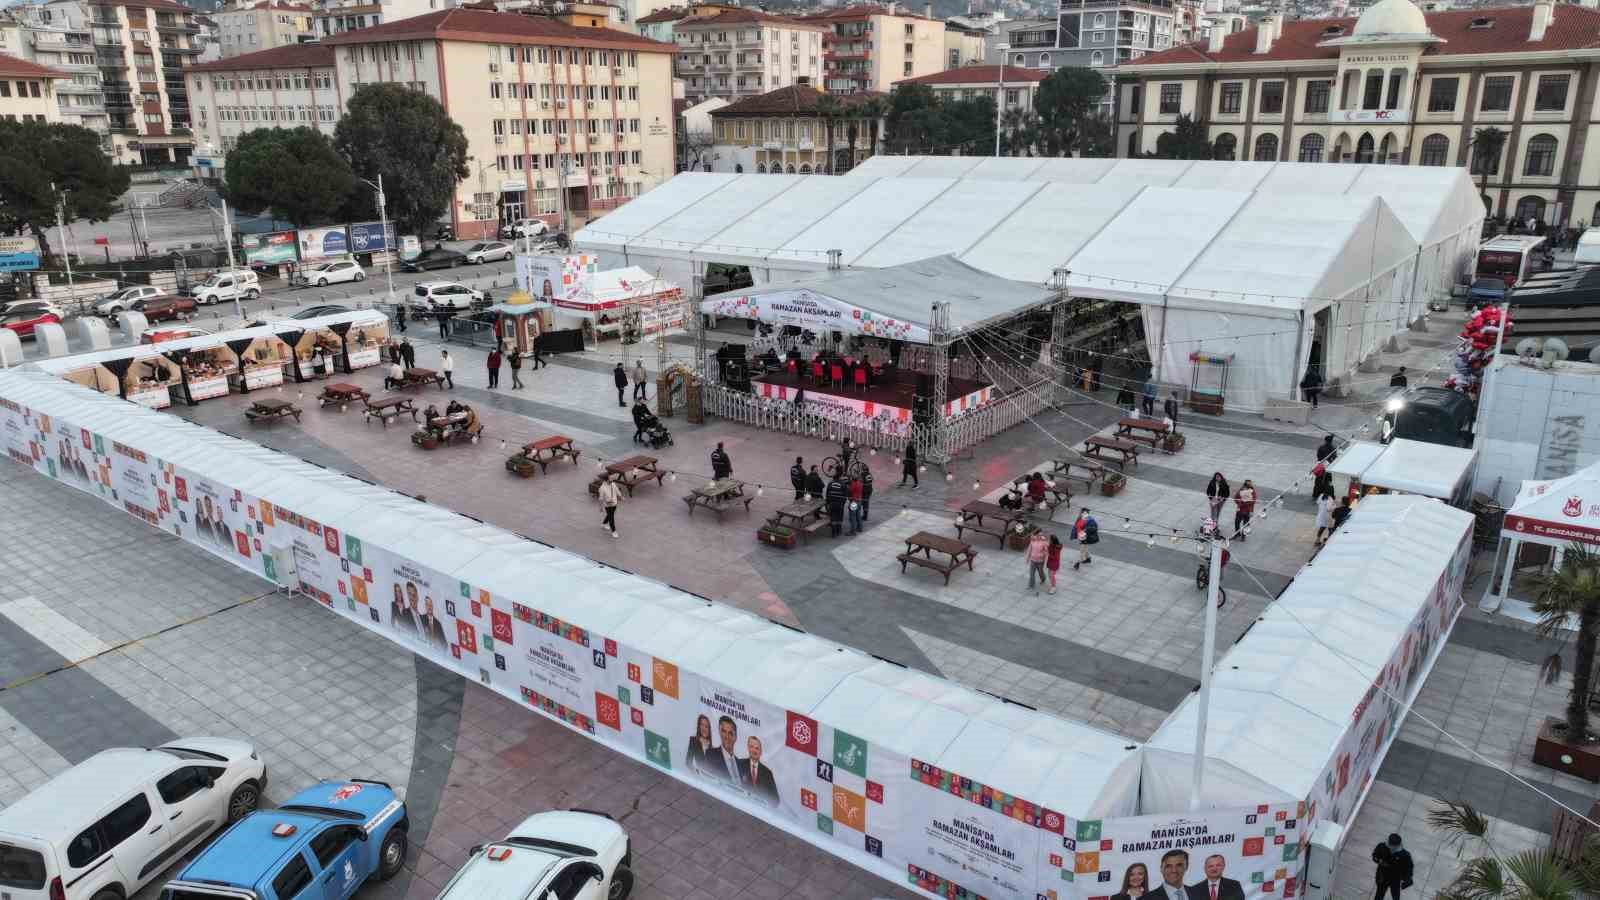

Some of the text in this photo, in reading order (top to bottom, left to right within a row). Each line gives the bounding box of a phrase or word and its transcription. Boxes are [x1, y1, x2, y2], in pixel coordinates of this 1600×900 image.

[771, 303, 802, 313] RAMAZAN
[932, 819, 969, 841] RAMAZAN
[953, 818, 995, 842] MANİSA'DA
[1151, 824, 1208, 840] MANİSA'DA
[1121, 833, 1236, 853] RAMAZAN AKŞAMLARI
